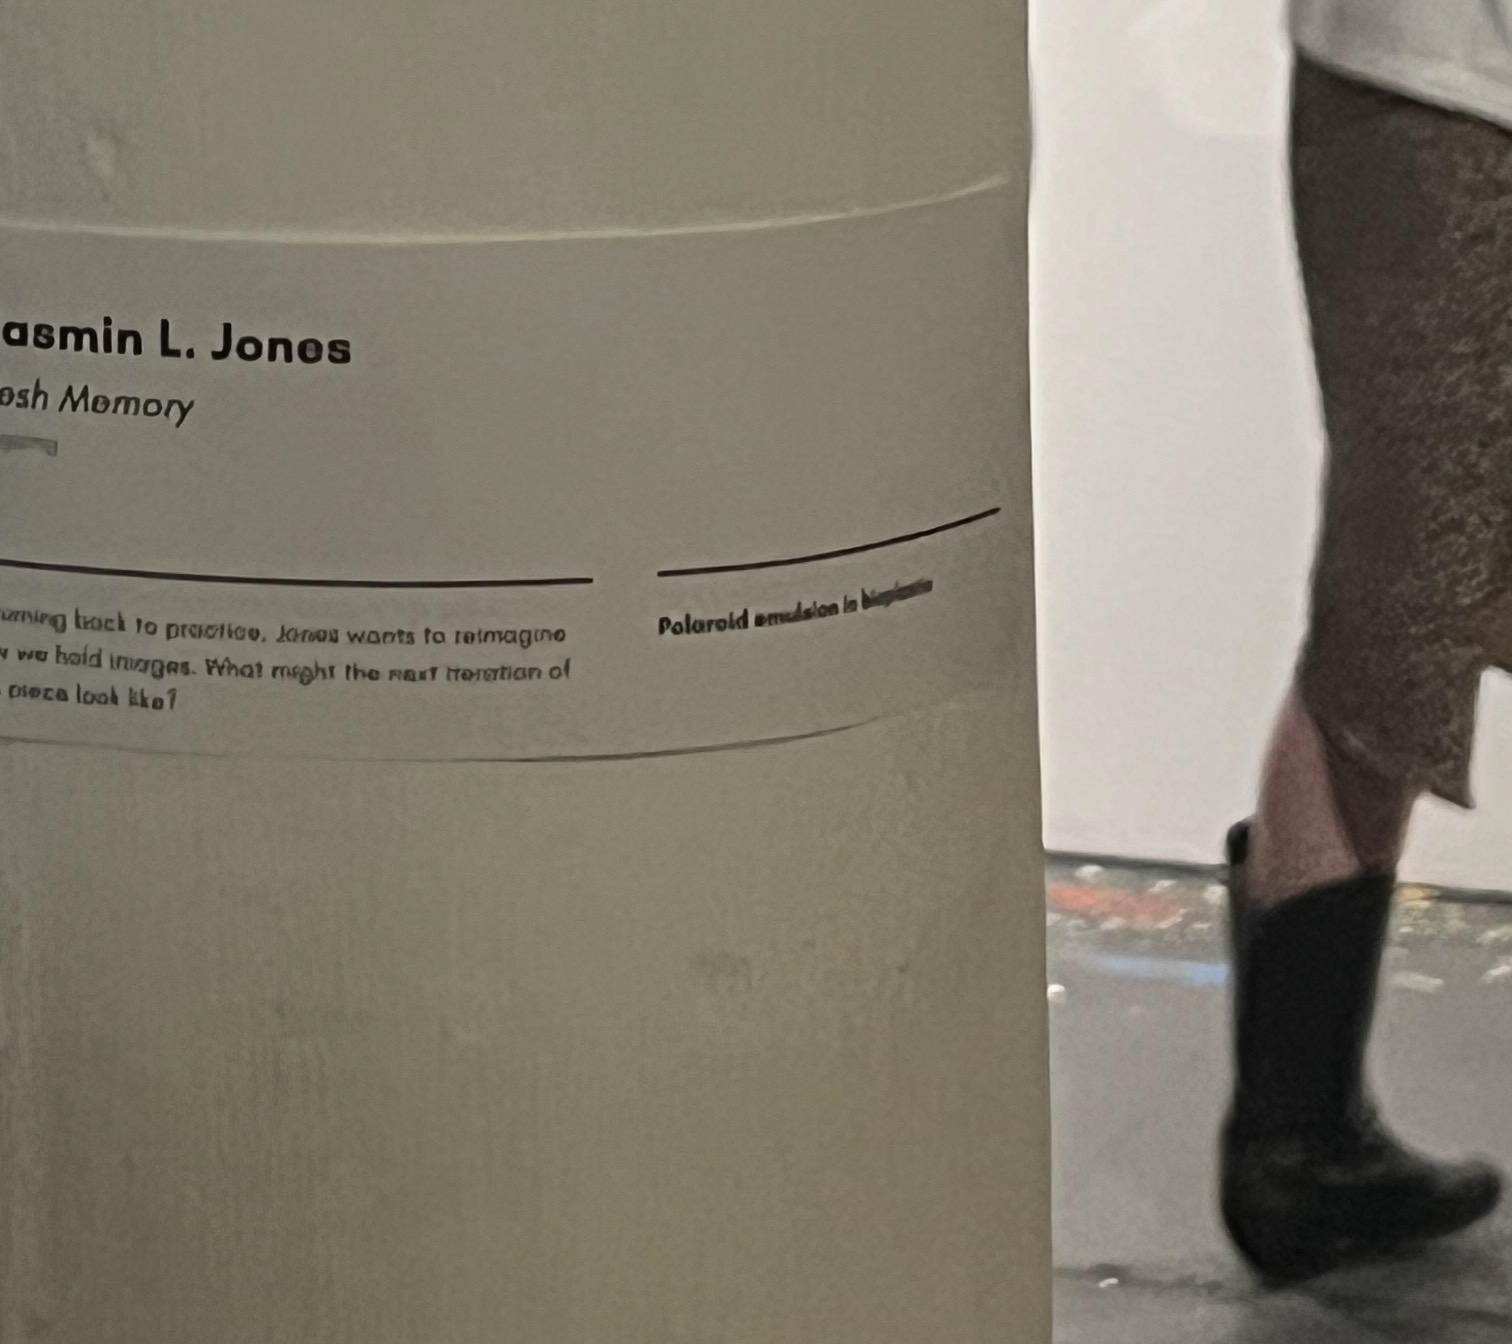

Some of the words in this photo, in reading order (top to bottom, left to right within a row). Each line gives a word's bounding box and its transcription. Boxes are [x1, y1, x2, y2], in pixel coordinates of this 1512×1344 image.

[159, 317, 196, 360] L.
[210, 321, 352, 365] Jones
[57, 384, 196, 429] Memory
[74, 607, 127, 633] back
[135, 617, 158, 637] to
[346, 627, 416, 646] wants
[423, 626, 447, 645] to
[454, 626, 567, 651] reimagine
[657, 607, 751, 637] Polaroid
[16, 648, 49, 663] we
[55, 644, 104, 670] hold
[204, 656, 264, 680] What
[271, 659, 336, 687] might
[344, 662, 381, 682] the
[387, 665, 439, 683] next
[547, 656, 573, 681] of
[7, 683, 70, 703] piece
[75, 682, 120, 707] look
[128, 686, 178, 712] like?
